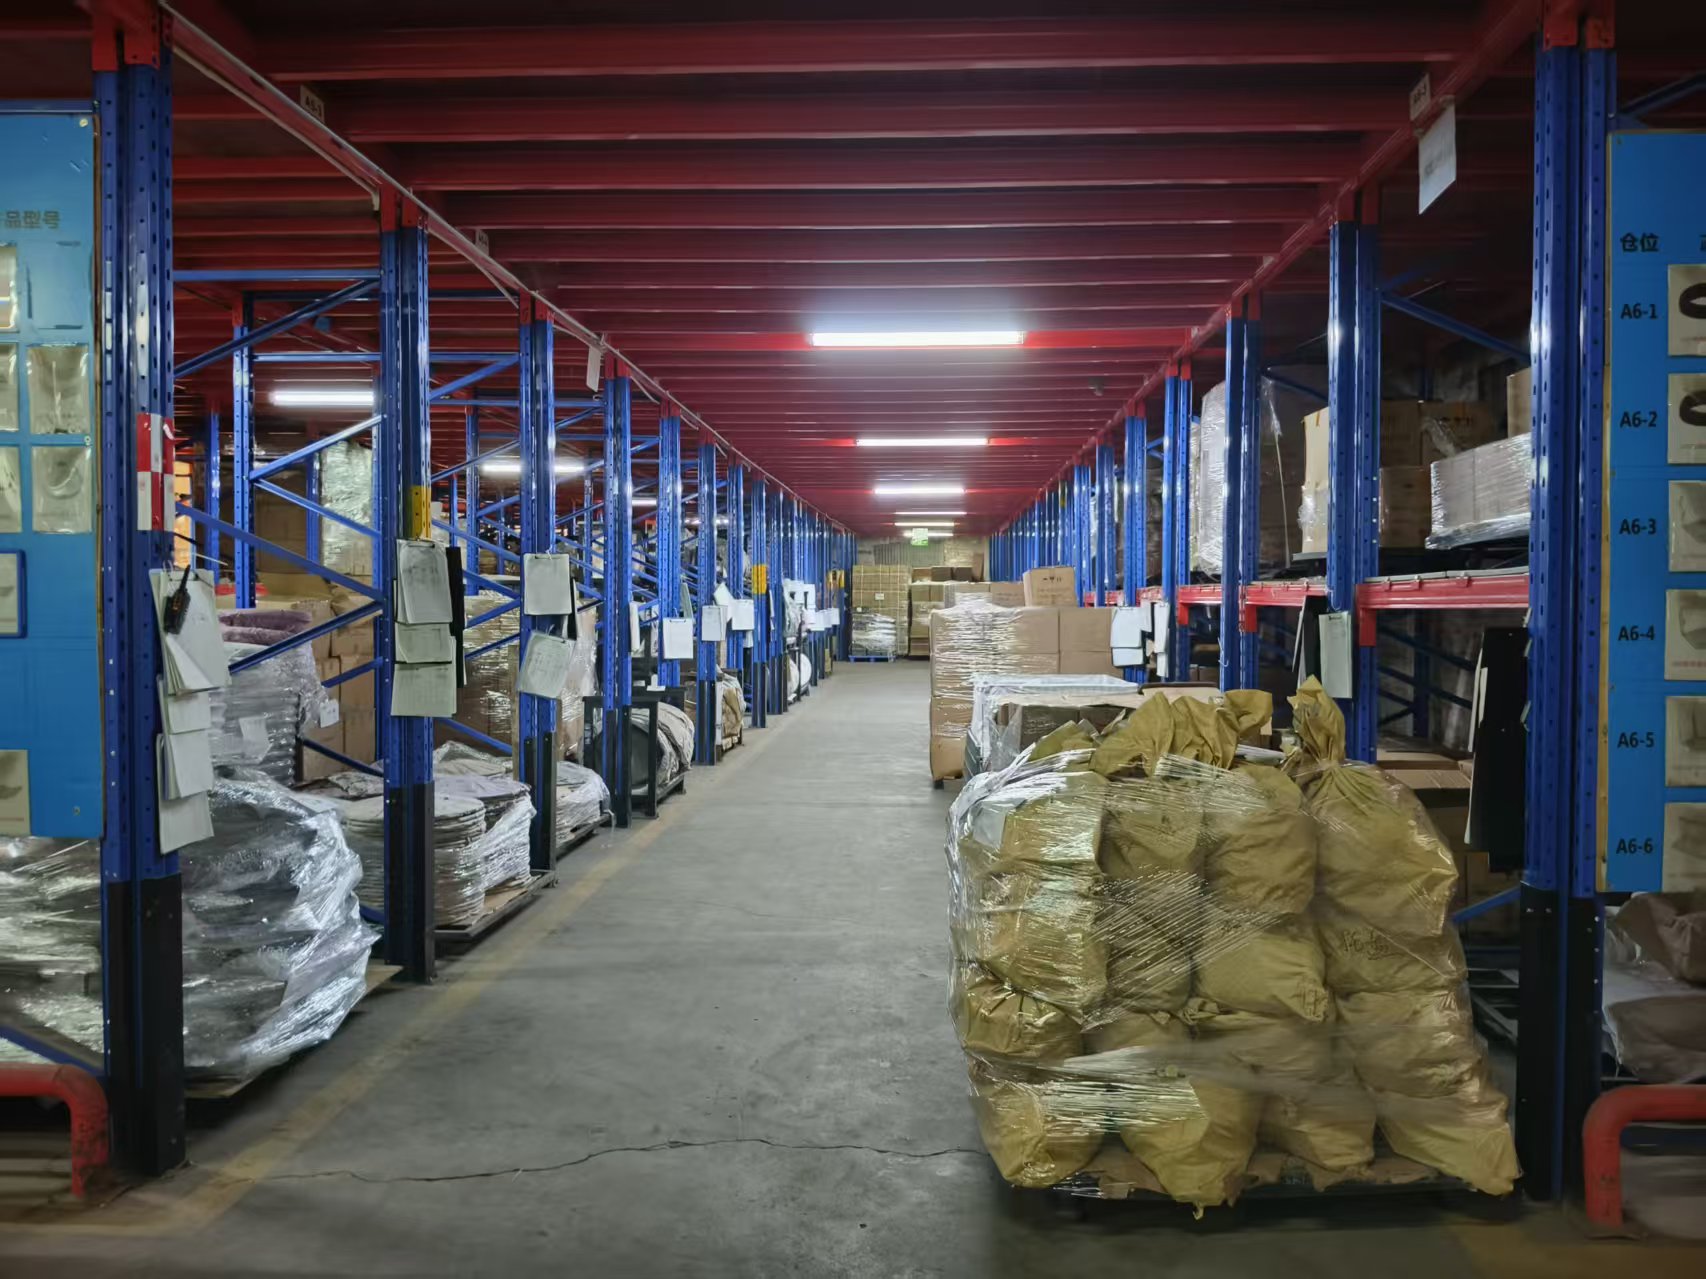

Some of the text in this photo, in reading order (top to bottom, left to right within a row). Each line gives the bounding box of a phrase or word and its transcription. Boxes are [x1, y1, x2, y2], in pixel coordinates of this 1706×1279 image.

[0, 210, 61, 230] 品型号
[1620, 232, 1660, 253] 仓位
[1620, 303, 1658, 320] A6-1
[1619, 410, 1658, 428] A6-2
[1619, 518, 1657, 535] A6-3
[1617, 624, 1656, 641] A6-4
[1617, 731, 1655, 749] A6-5
[1616, 838, 1654, 854] A6-6
